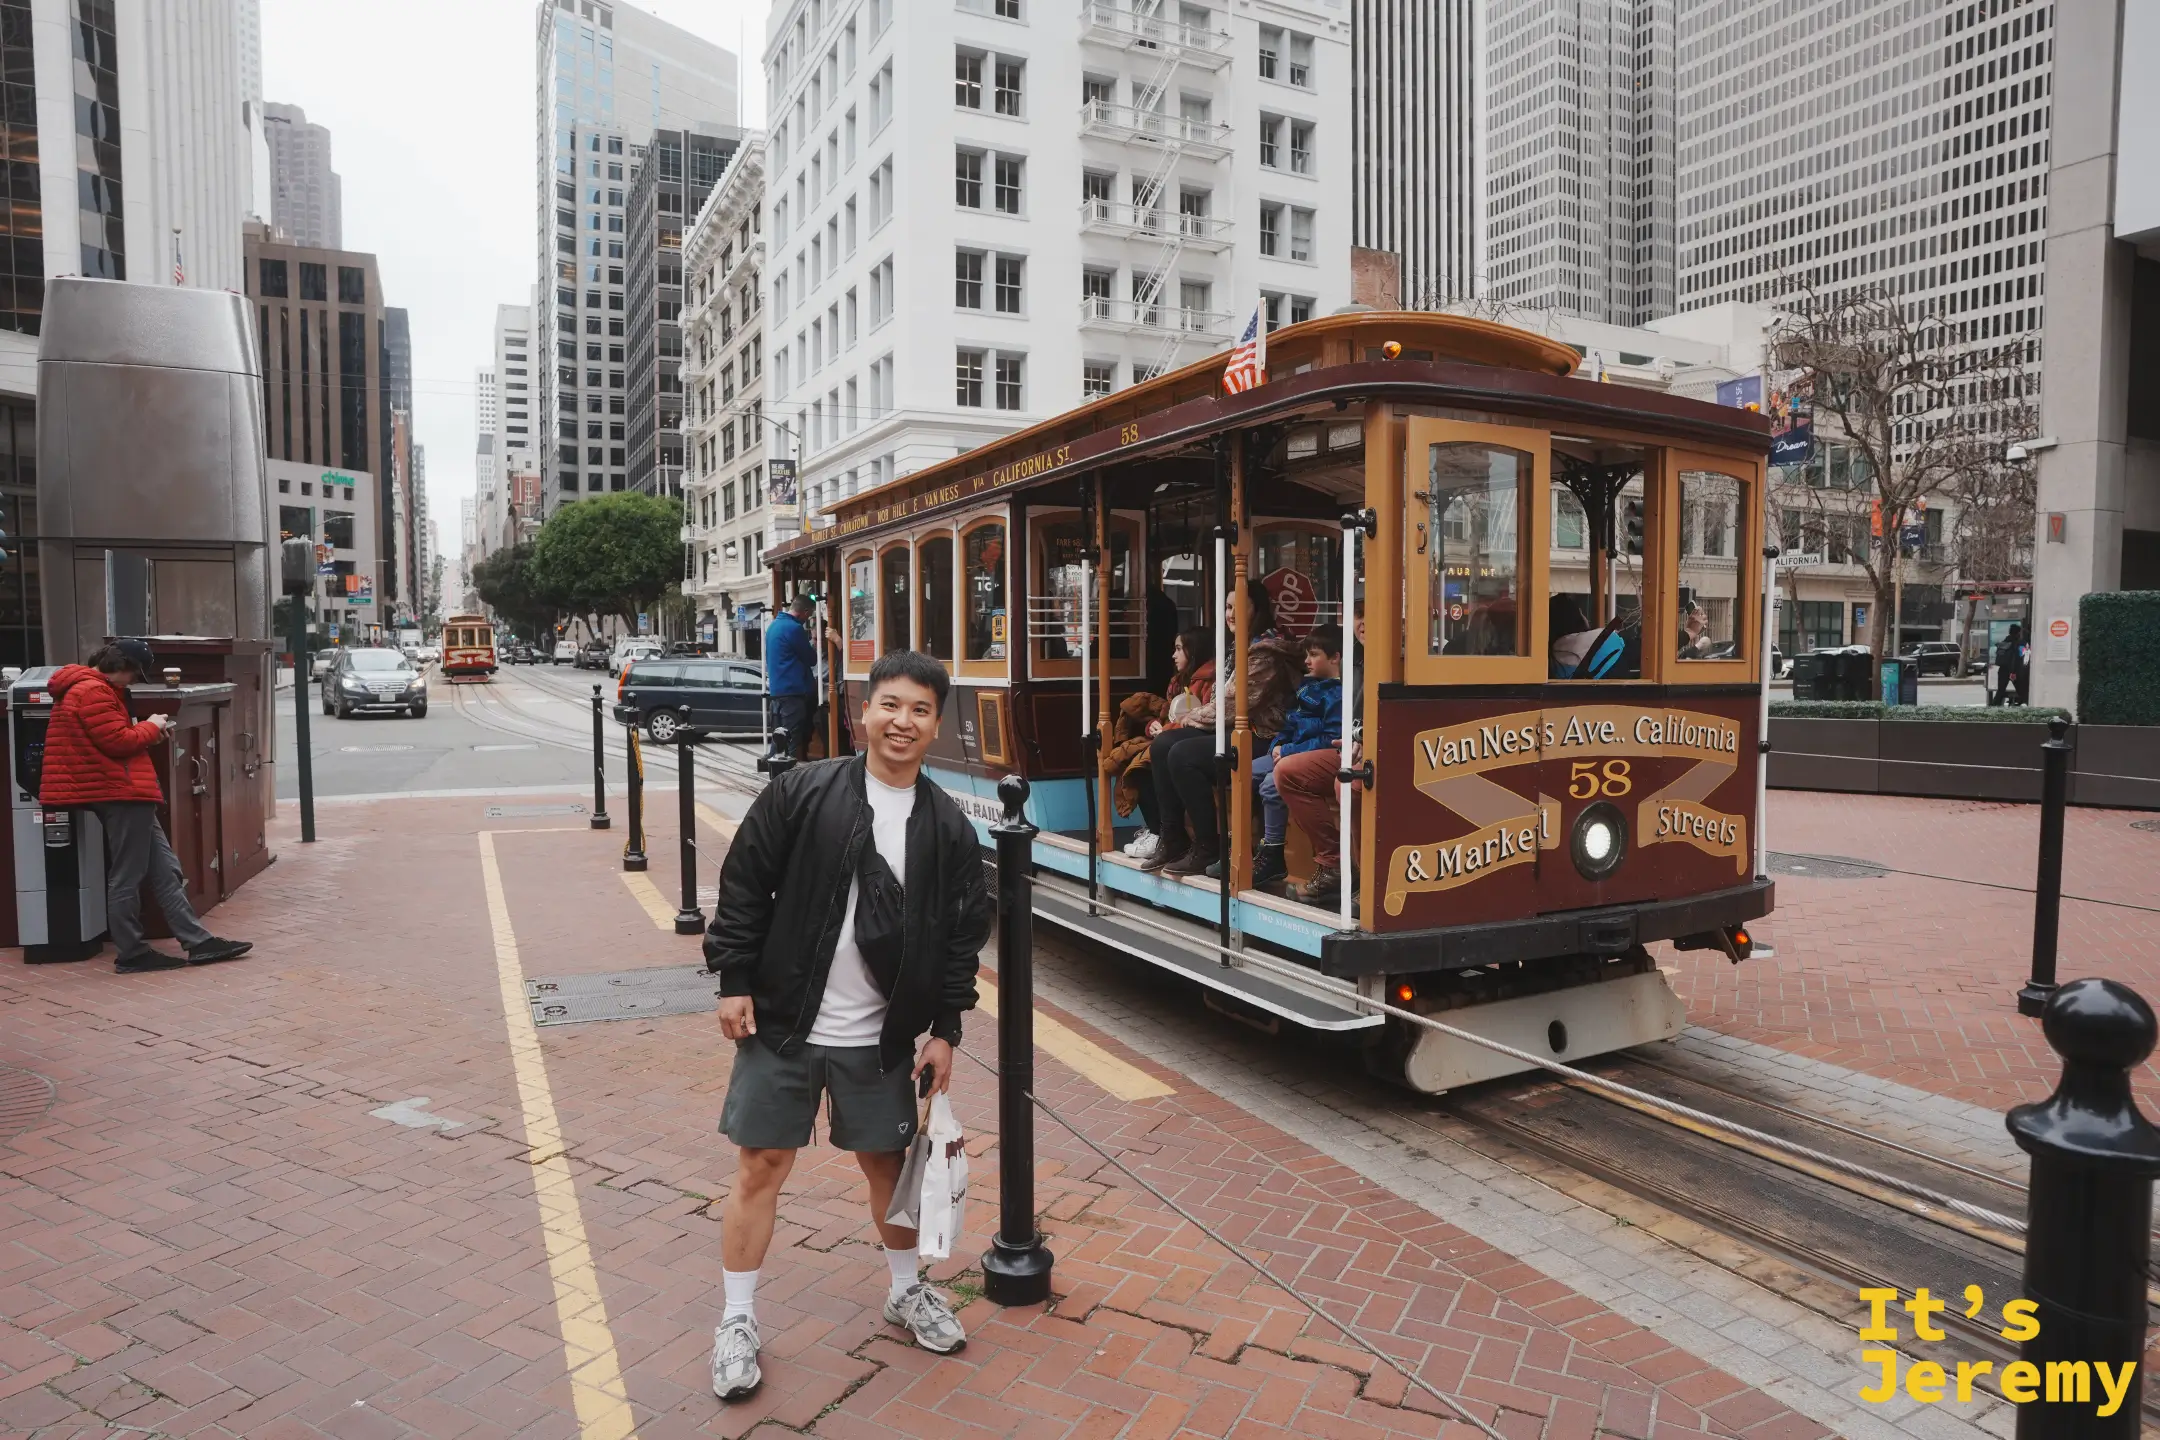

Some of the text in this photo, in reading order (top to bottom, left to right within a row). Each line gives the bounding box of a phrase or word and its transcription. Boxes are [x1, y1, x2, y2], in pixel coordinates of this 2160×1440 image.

[1776, 440, 1808, 453] Dream
[839, 515, 869, 535] CHINATOWN
[877, 508, 889, 523] NOB
[892, 504, 907, 519] HILL
[913, 498, 918, 512] &
[924, 491, 940, 507] VAN
[938, 484, 959, 502] NESS
[973, 477, 985, 492] VIA
[993, 454, 1053, 487] CALIFORNIA
[1120, 423, 1139, 446] 58
[1056, 538, 1072, 546] FARE
[1775, 555, 1819, 566] ALIFORNIA
[1421, 735, 1478, 770] Van
[1633, 714, 1736, 753] California
[1569, 759, 1632, 799] 58
[973, 802, 1004, 825] RAILW
[1405, 805, 1738, 883] & Market Streets
[1257, 911, 1274, 924] TWO
[1275, 917, 1310, 935] STANDEES
